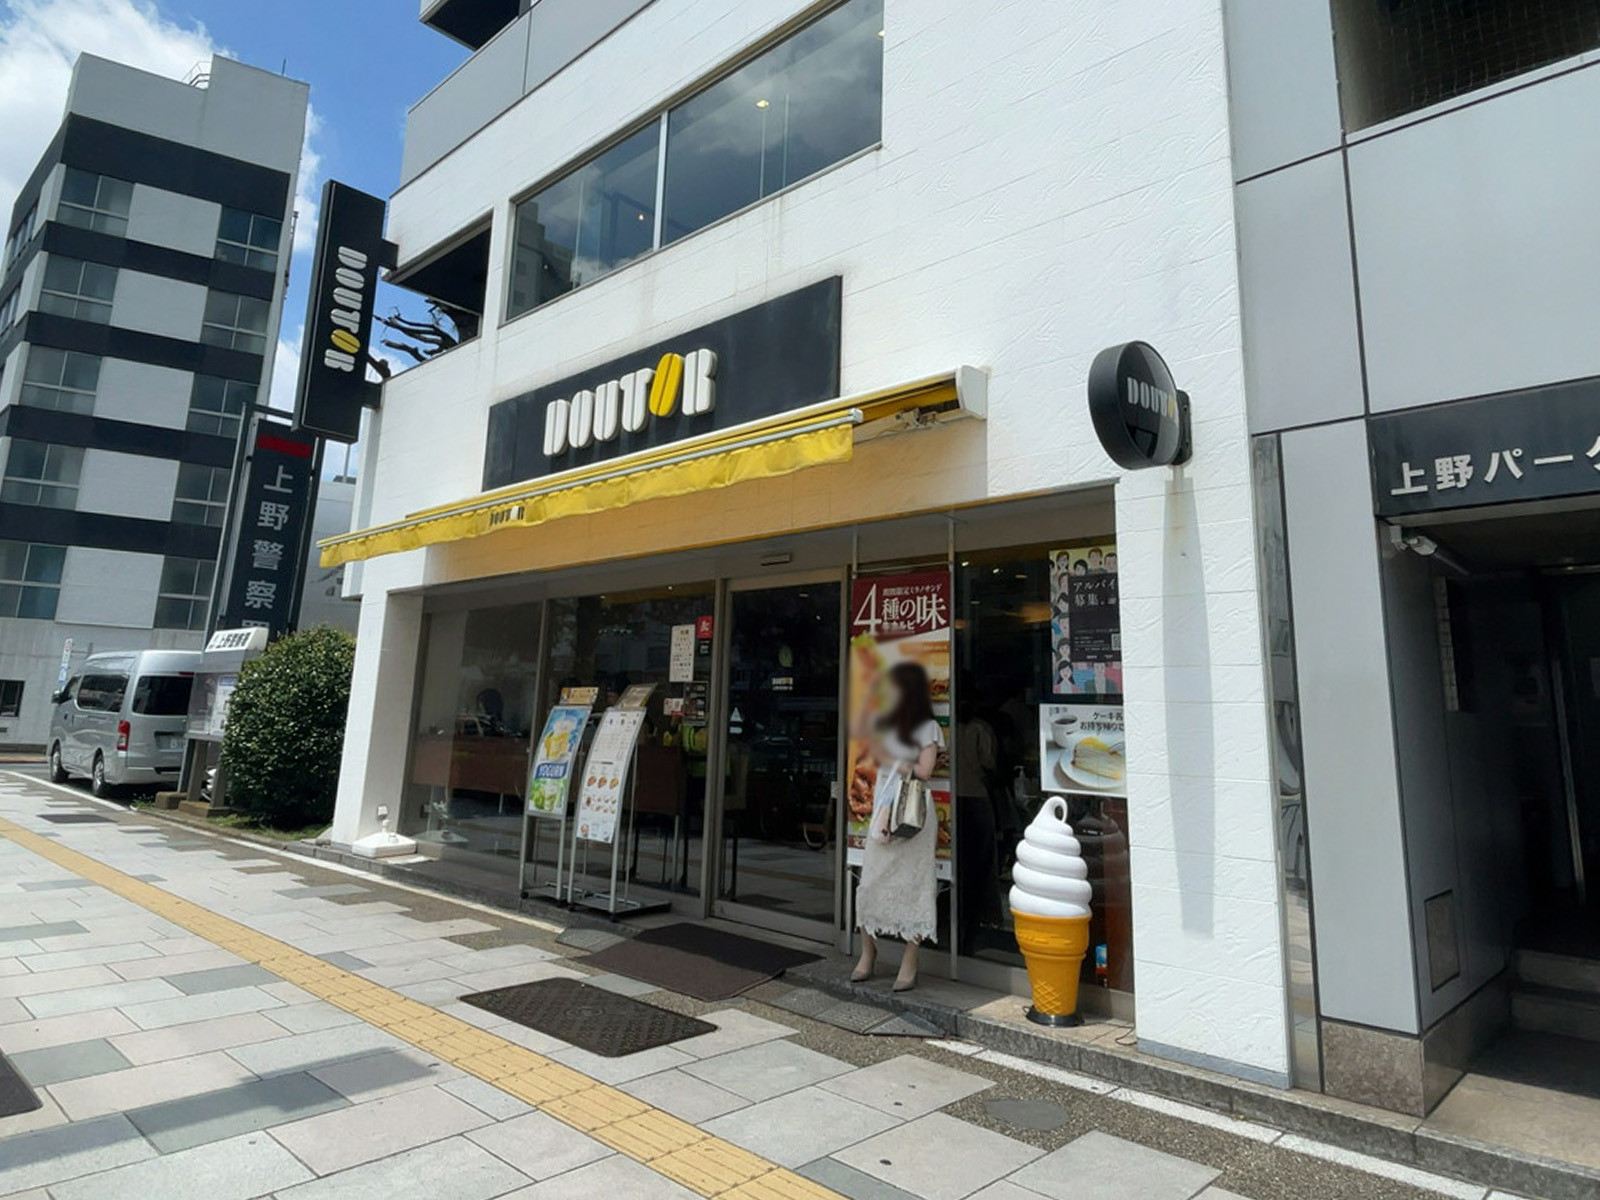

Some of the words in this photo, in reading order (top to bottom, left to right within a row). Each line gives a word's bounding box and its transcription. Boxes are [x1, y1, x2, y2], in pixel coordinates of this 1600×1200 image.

[324, 245, 368, 373] DOUTOR
[543, 348, 718, 457] DOUTOR
[1126, 376, 1179, 418] DOUTO
[853, 583, 947, 634] 4種の味
